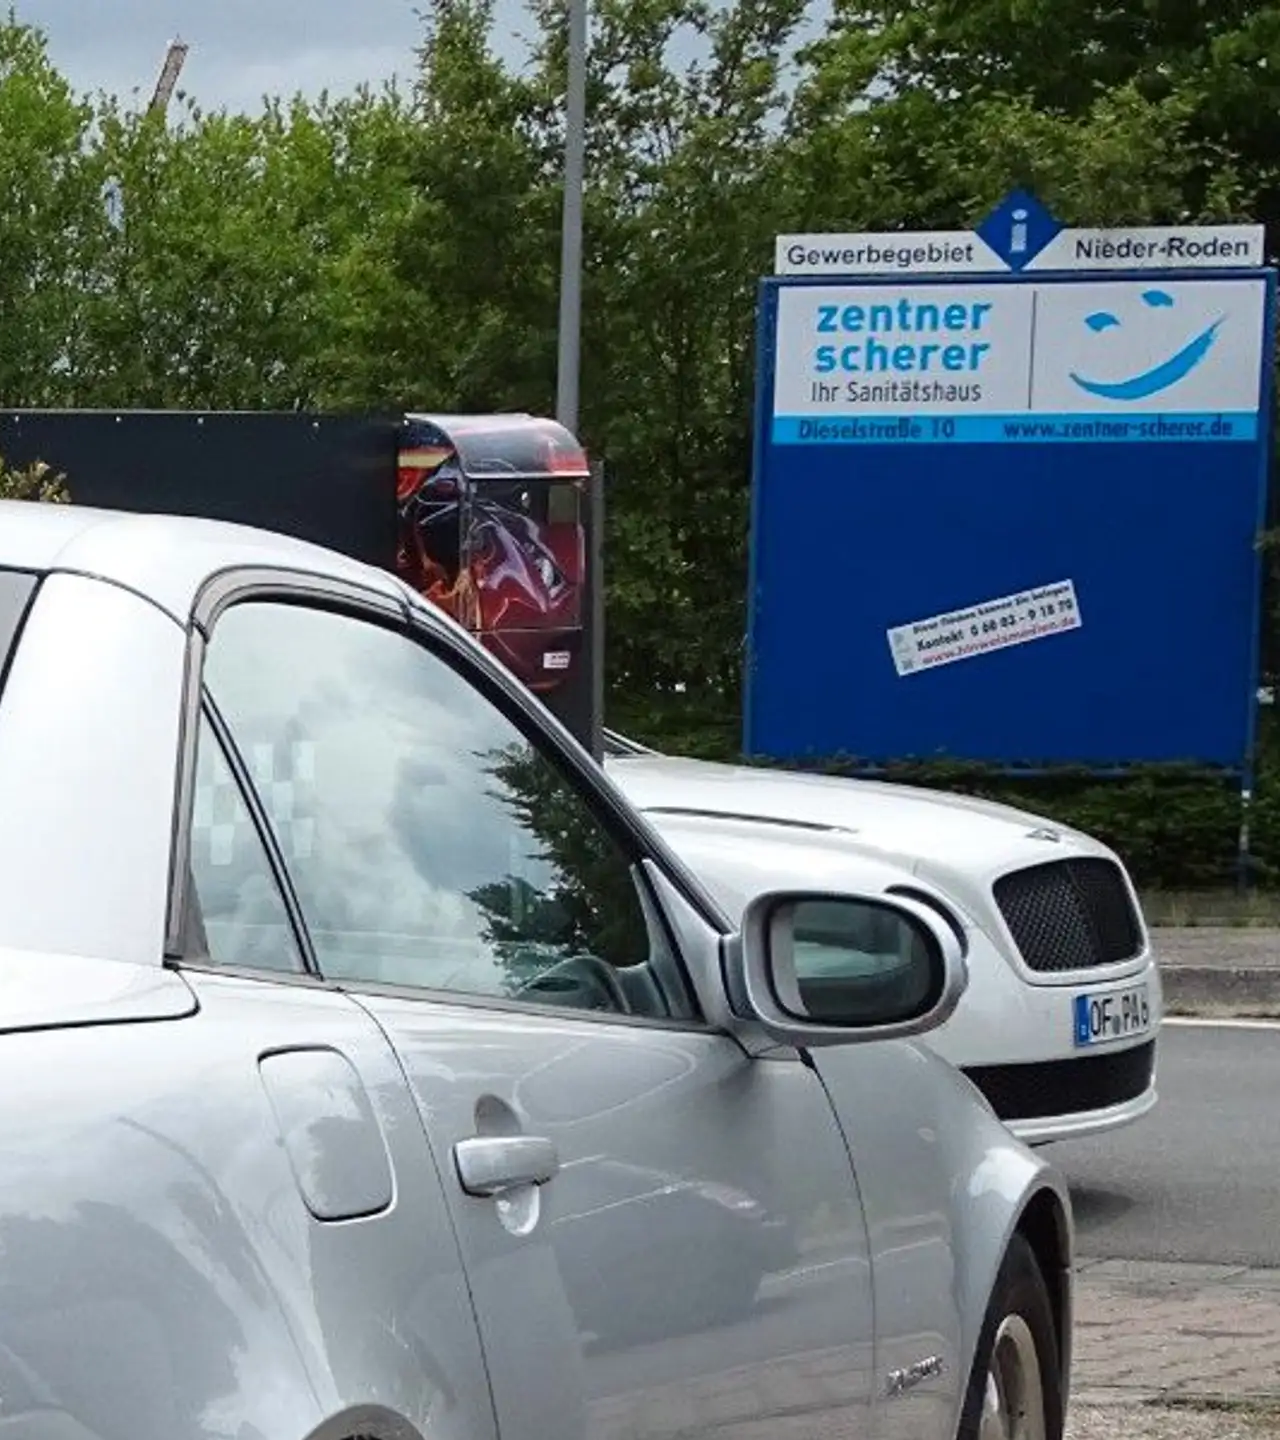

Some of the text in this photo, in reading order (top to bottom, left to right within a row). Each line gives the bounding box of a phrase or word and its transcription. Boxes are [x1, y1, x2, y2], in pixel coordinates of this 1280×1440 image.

[787, 236, 1250, 267] Gewerbegebiet Nieder-Roden
[817, 298, 993, 332] zentner
[814, 337, 991, 372] scherer
[812, 380, 982, 401] Ihr Sanitätshaus
[799, 417, 955, 439] Dieselstraße 10
[1003, 413, 1233, 438] www.zentner-scherer.de
[917, 630, 965, 651] Kontakt
[1091, 999, 1113, 1035] OF
